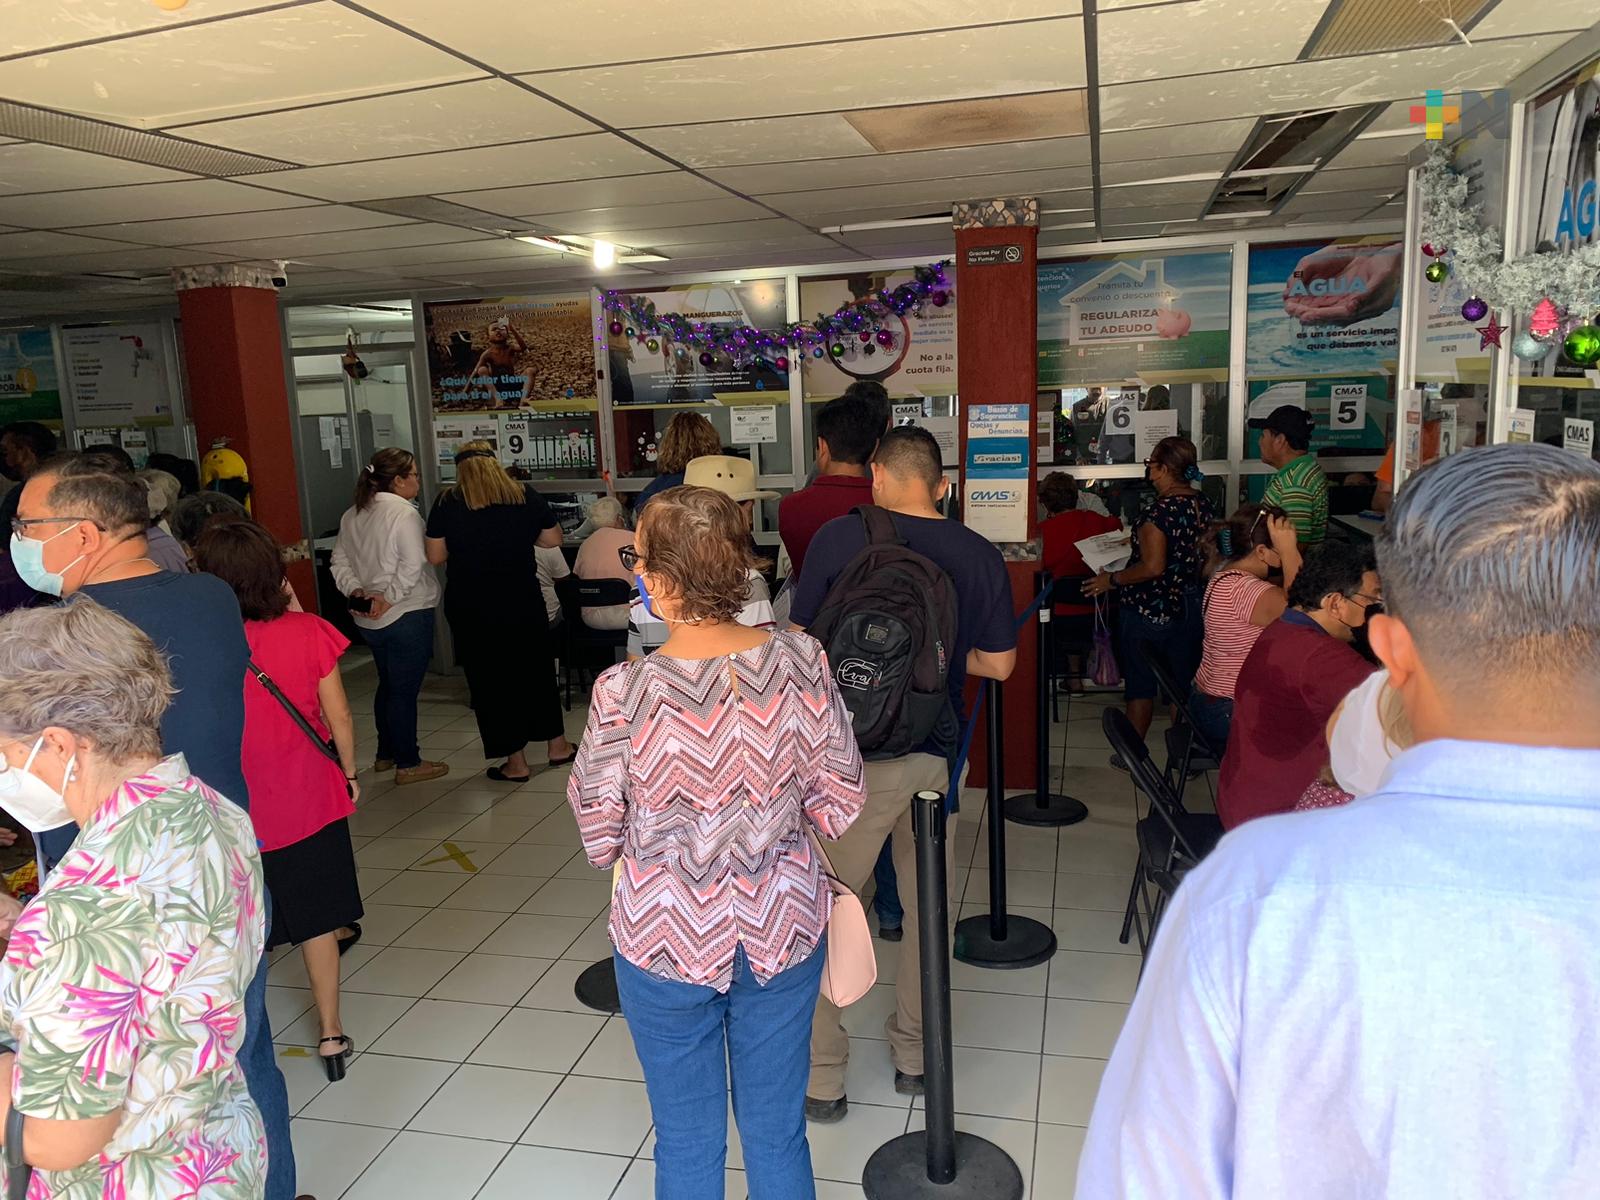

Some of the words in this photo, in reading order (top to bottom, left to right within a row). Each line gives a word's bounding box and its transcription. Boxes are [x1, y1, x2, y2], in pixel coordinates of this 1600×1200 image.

[1555, 179, 1600, 243] AG
[1097, 281, 1131, 290] Tramita
[1134, 280, 1144, 288] tu
[1289, 278, 1368, 296] AGUA
[1070, 293, 1111, 304] convenio
[1080, 308, 1159, 321] REGULARIZA
[1080, 326, 1096, 336] TU
[1100, 323, 1153, 335] ADEUDO
[1327, 329, 1367, 337] servicio
[1307, 343, 1326, 351] que
[1329, 340, 1377, 349] debemos
[1380, 338, 1398, 346] val
[920, 354, 934, 362] No
[905, 367, 933, 375] cuota
[935, 365, 954, 374] fija.
[440, 376, 467, 387] ¿Qué
[470, 376, 498, 385] valor
[501, 375, 529, 384] tiene
[1334, 387, 1364, 396] CMAS
[1112, 406, 1132, 429] 6
[1337, 401, 1358, 424] 5
[505, 423, 526, 431] CMAS
[1566, 424, 1590, 442] CMAS
[508, 434, 524, 455] 9
[970, 490, 1010, 501] CMAS
